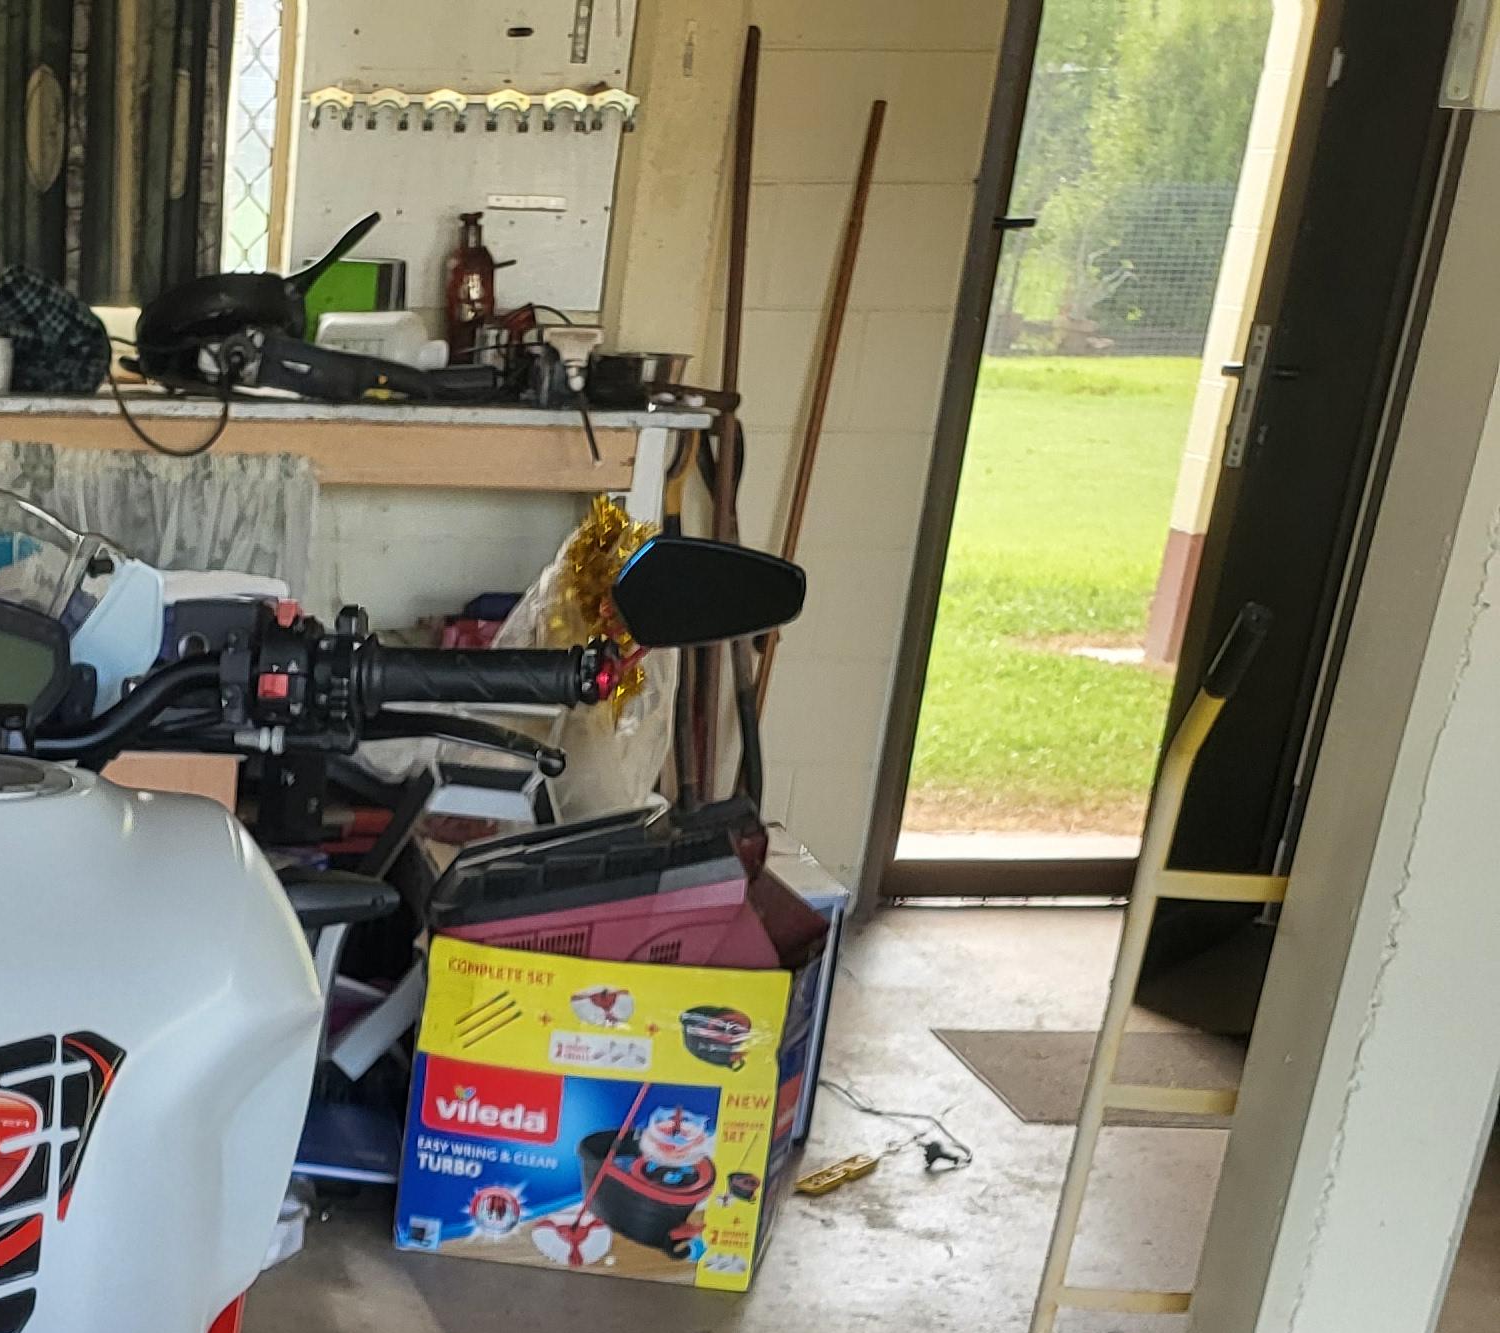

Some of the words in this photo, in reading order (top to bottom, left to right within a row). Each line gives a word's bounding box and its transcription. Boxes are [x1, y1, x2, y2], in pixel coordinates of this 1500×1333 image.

[447, 957, 522, 982] COMPLETE
[527, 970, 555, 986] SET
[436, 1096, 547, 1133] vileda
[726, 1093, 770, 1109] NEW
[417, 1135, 450, 1154] EASY
[451, 1142, 498, 1162] WRING
[500, 1150, 512, 1164] &
[514, 1151, 558, 1169] CLEAN
[417, 1151, 482, 1178] TURBO
